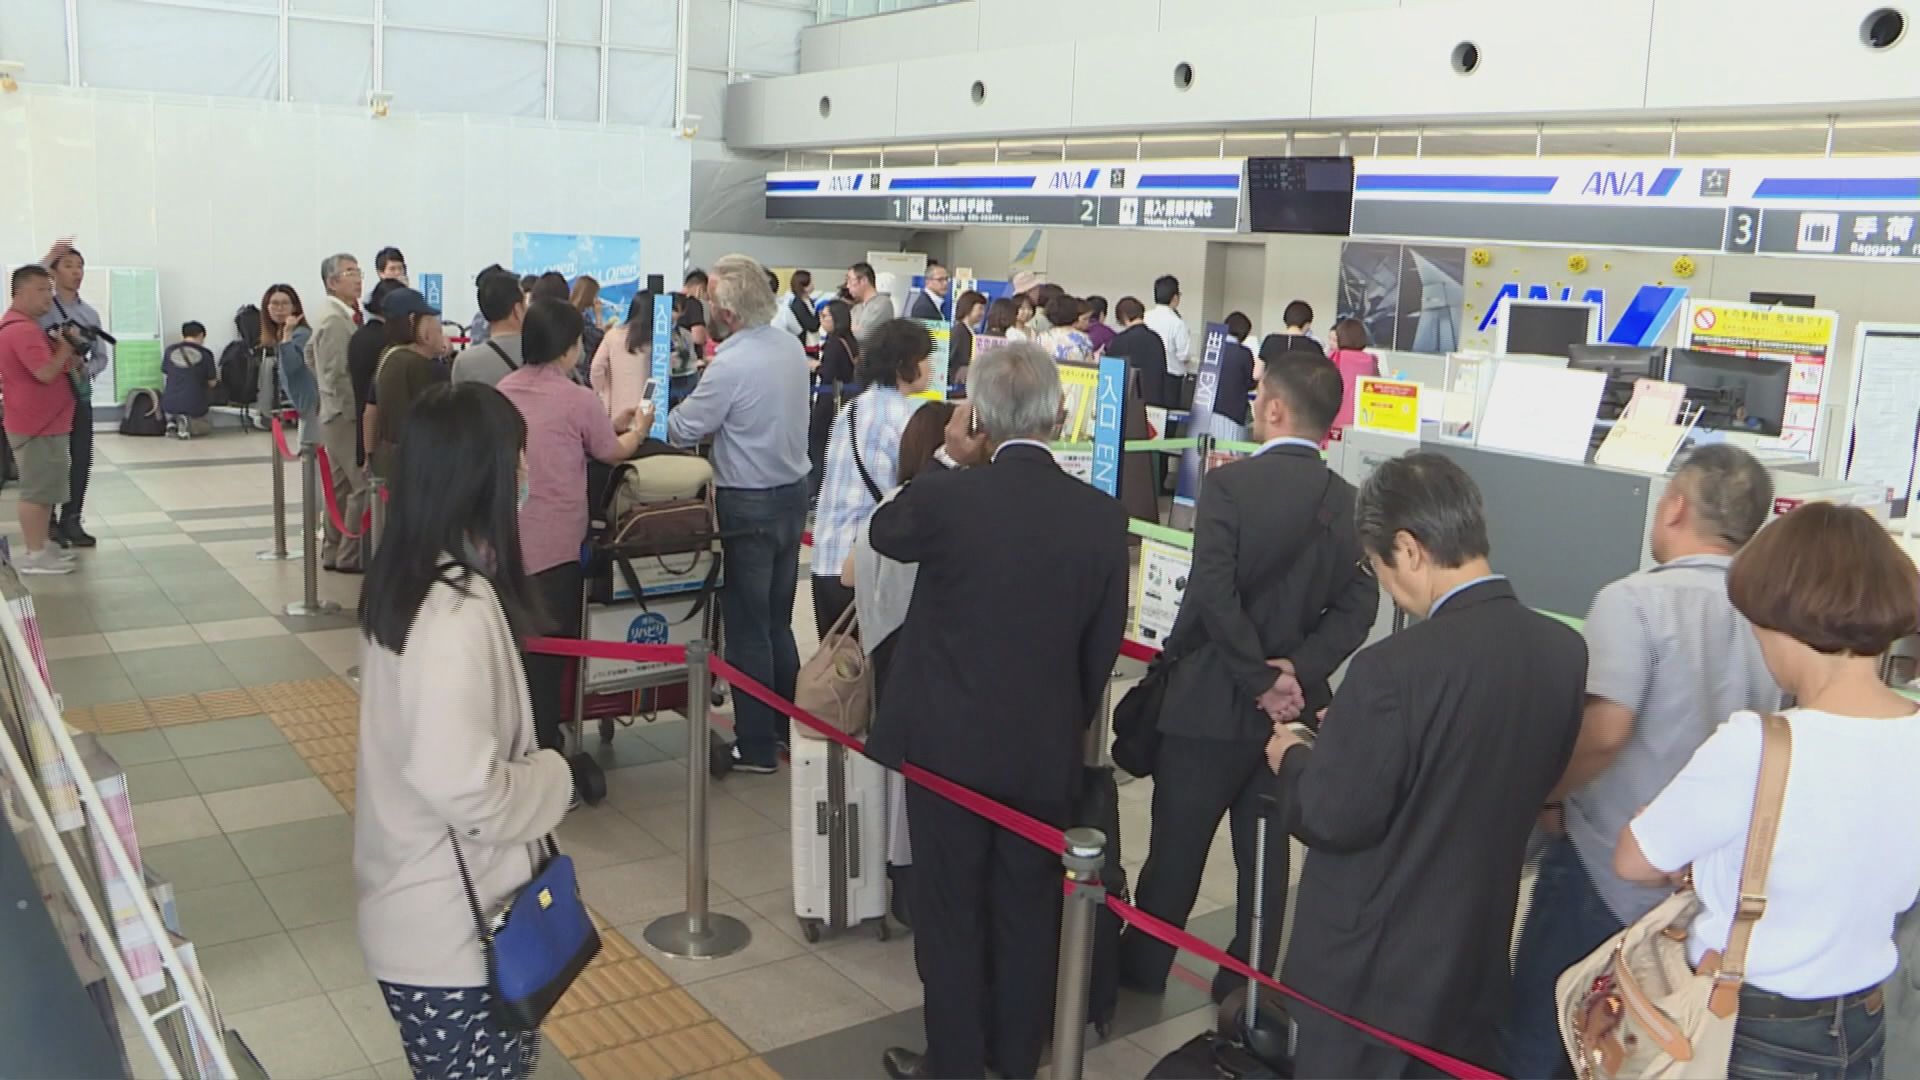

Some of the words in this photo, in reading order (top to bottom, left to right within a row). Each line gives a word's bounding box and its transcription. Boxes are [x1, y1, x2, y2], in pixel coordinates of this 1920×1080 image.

[1048, 171, 1082, 190] ANA
[1581, 171, 1644, 196] ANA
[892, 199, 902, 219] 1
[1079, 199, 1094, 221] 2
[1733, 213, 1753, 246] 3
[1849, 242, 1902, 257] Baggage
[655, 303, 668, 337] 入口
[1203, 331, 1224, 366] 出口
[652, 343, 668, 433] ENTRANCE
[1099, 375, 1119, 430] 入口
[1194, 371, 1217, 411] EXIT
